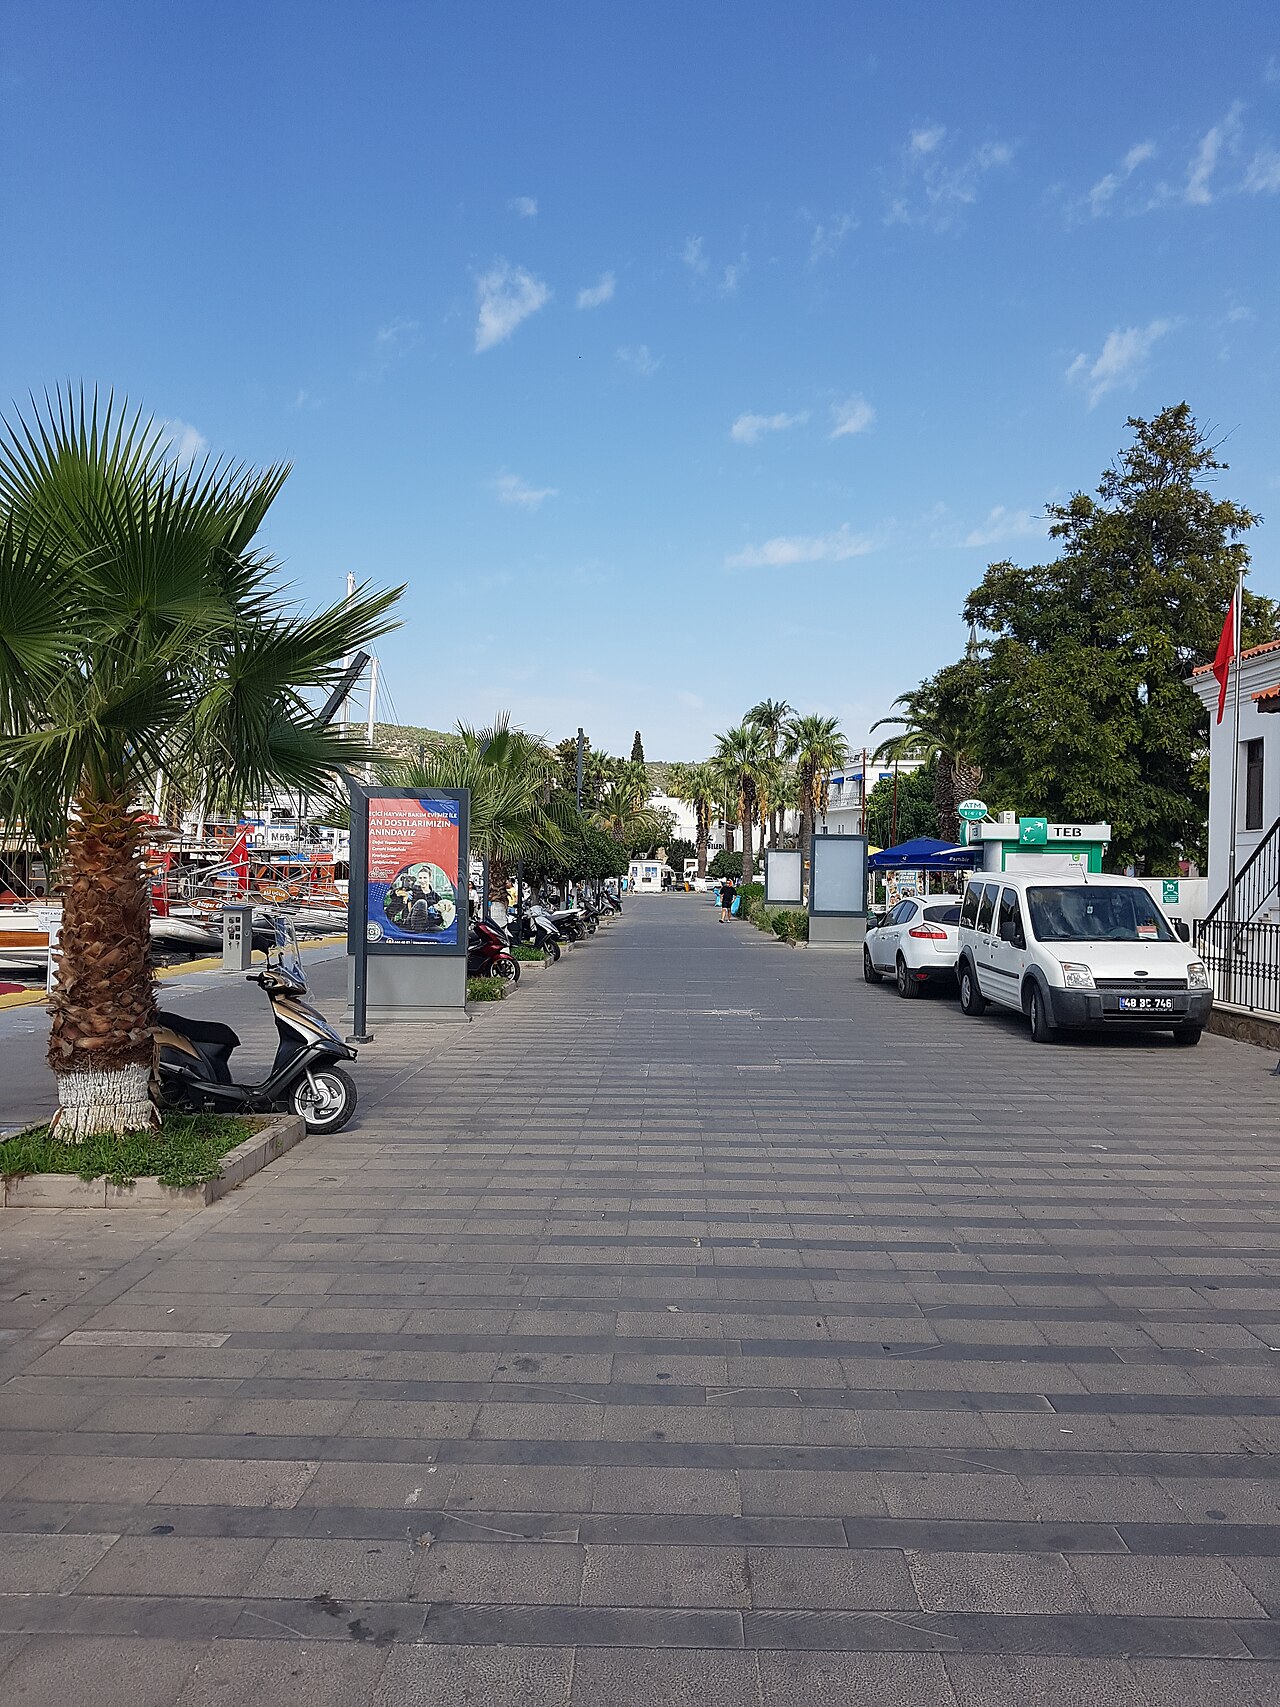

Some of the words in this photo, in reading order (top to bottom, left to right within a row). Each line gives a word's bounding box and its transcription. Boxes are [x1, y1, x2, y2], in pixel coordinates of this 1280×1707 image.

[427, 811, 448, 819] EVİMİZ
[449, 811, 458, 820] İLE
[384, 819, 451, 828] DOSTLARIMIZIN
[1053, 828, 1082, 837] TEB
[1125, 998, 1137, 1008] 48
[1154, 998, 1172, 1008] 746
